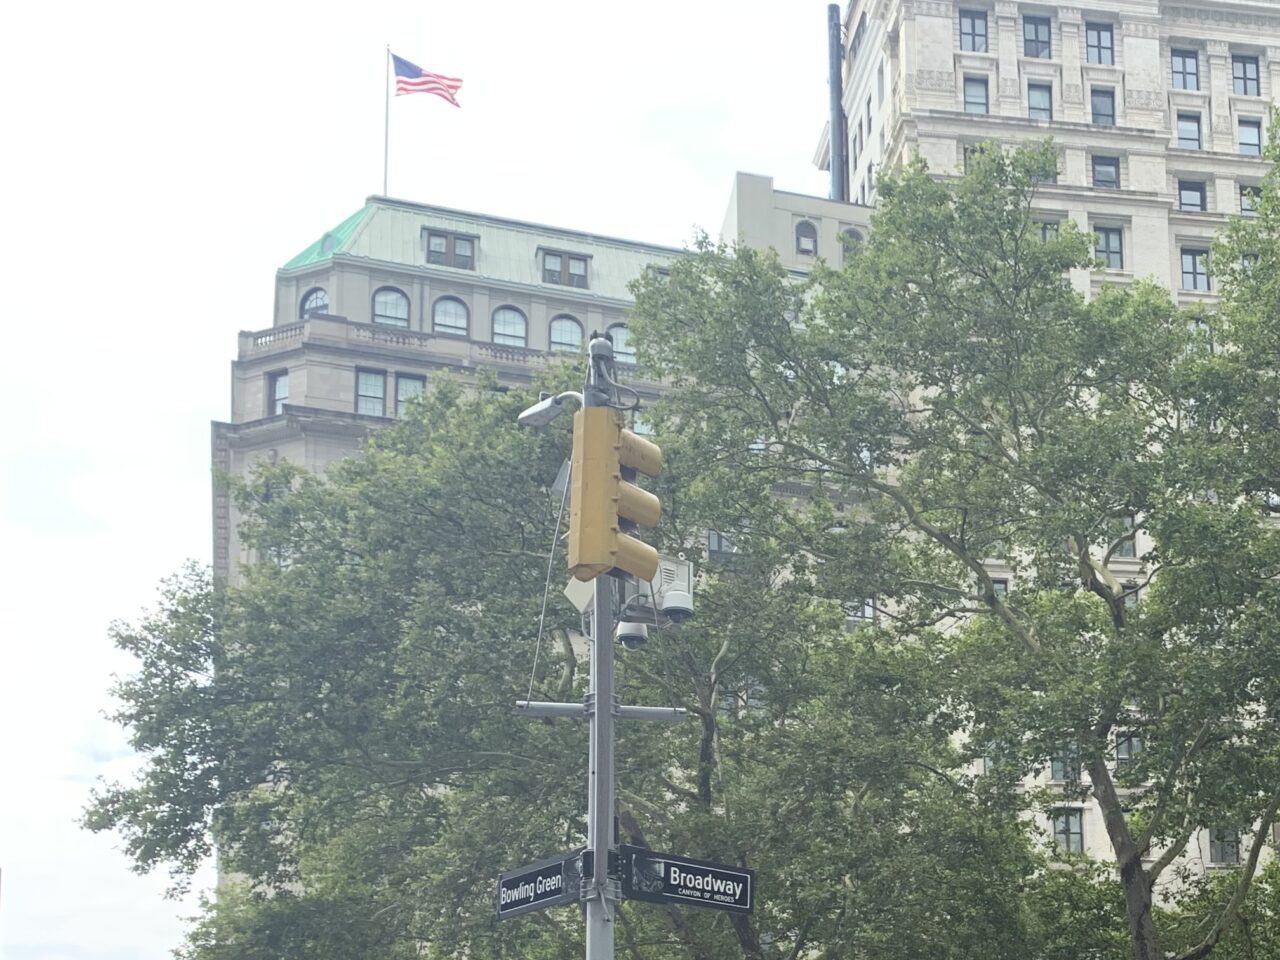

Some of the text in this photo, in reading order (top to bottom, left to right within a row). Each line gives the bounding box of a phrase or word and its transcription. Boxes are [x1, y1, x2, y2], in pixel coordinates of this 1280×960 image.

[501, 873, 562, 905] Bowling Green
[670, 867, 743, 899] Broadway
[678, 887, 735, 903] CANYON OF HEROES
